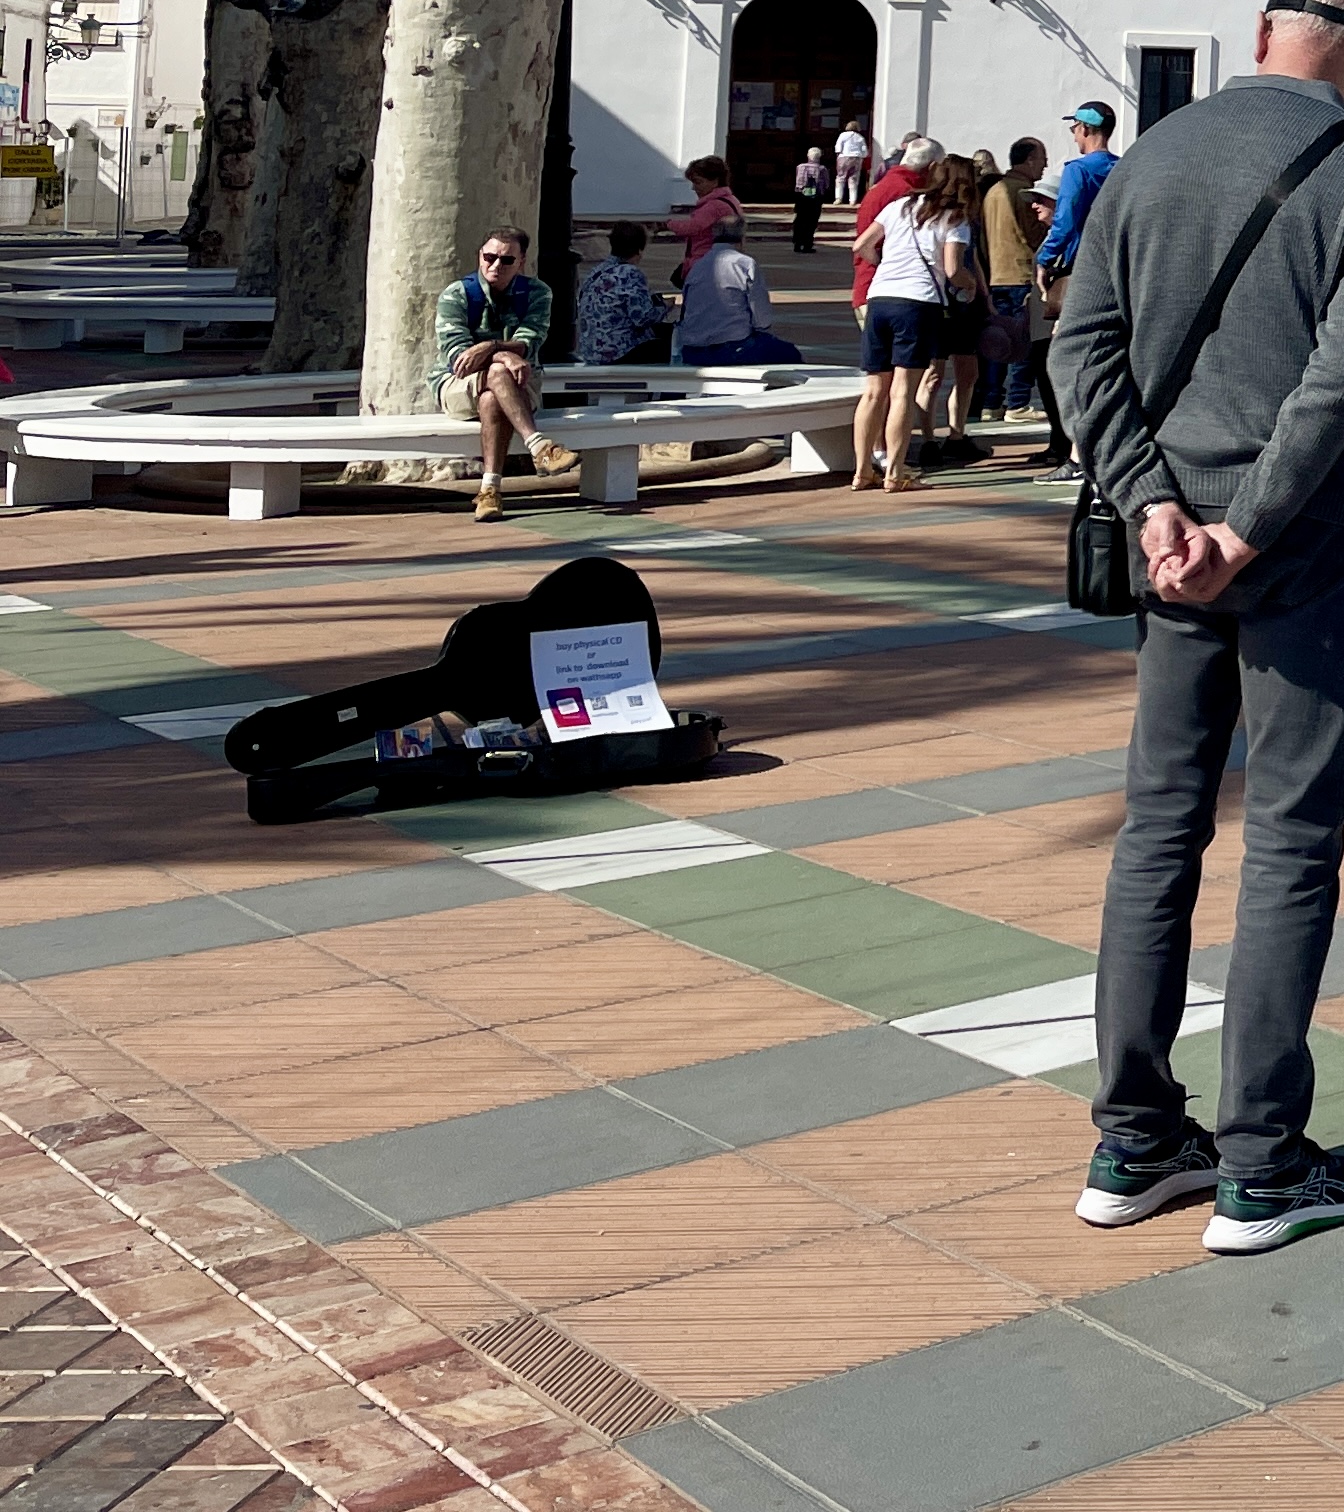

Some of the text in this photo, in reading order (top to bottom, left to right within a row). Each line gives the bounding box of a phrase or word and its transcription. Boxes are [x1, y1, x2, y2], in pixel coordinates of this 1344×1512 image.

[556, 636, 623, 651] buy physical CD
[556, 658, 630, 674] link to download
